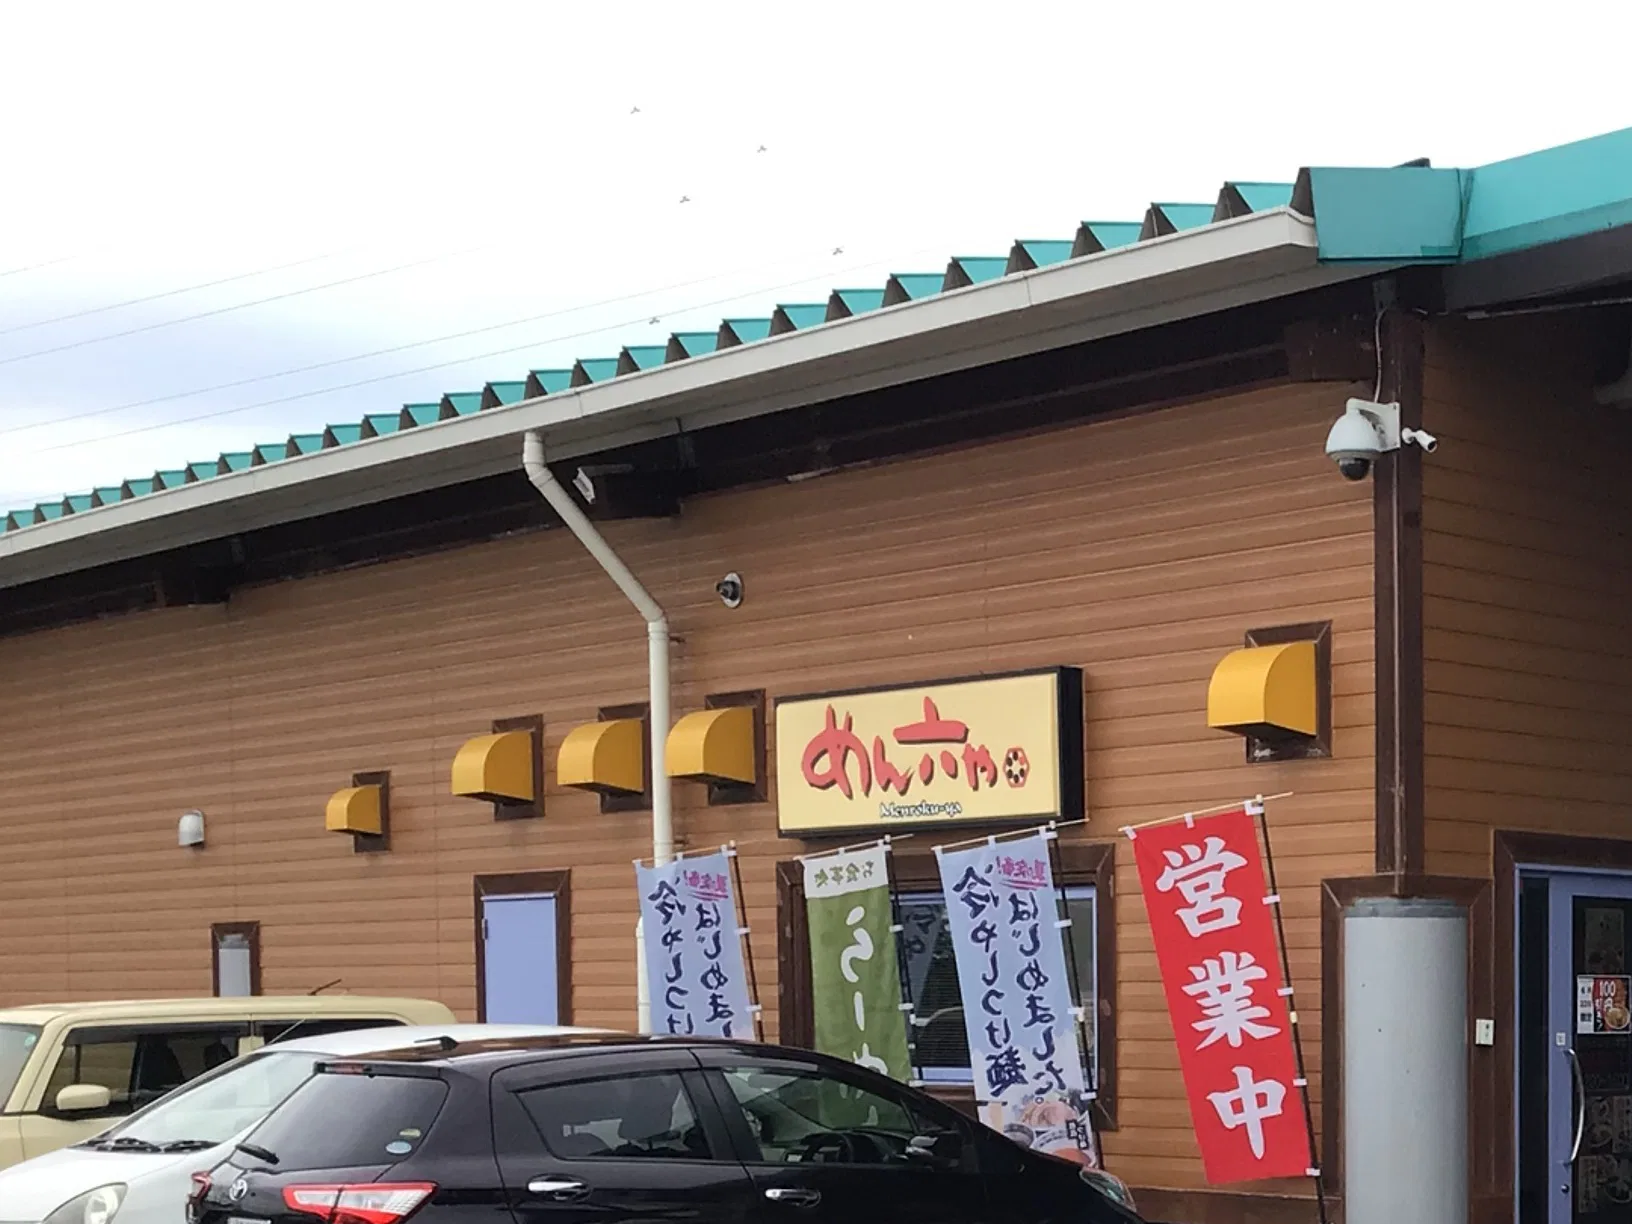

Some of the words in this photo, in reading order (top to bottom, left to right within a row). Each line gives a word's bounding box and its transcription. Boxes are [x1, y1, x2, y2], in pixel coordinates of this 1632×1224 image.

[801, 696, 998, 800] めん六や
[878, 801, 963, 818] Menroku-ya
[1155, 836, 1288, 1161] 営業中
